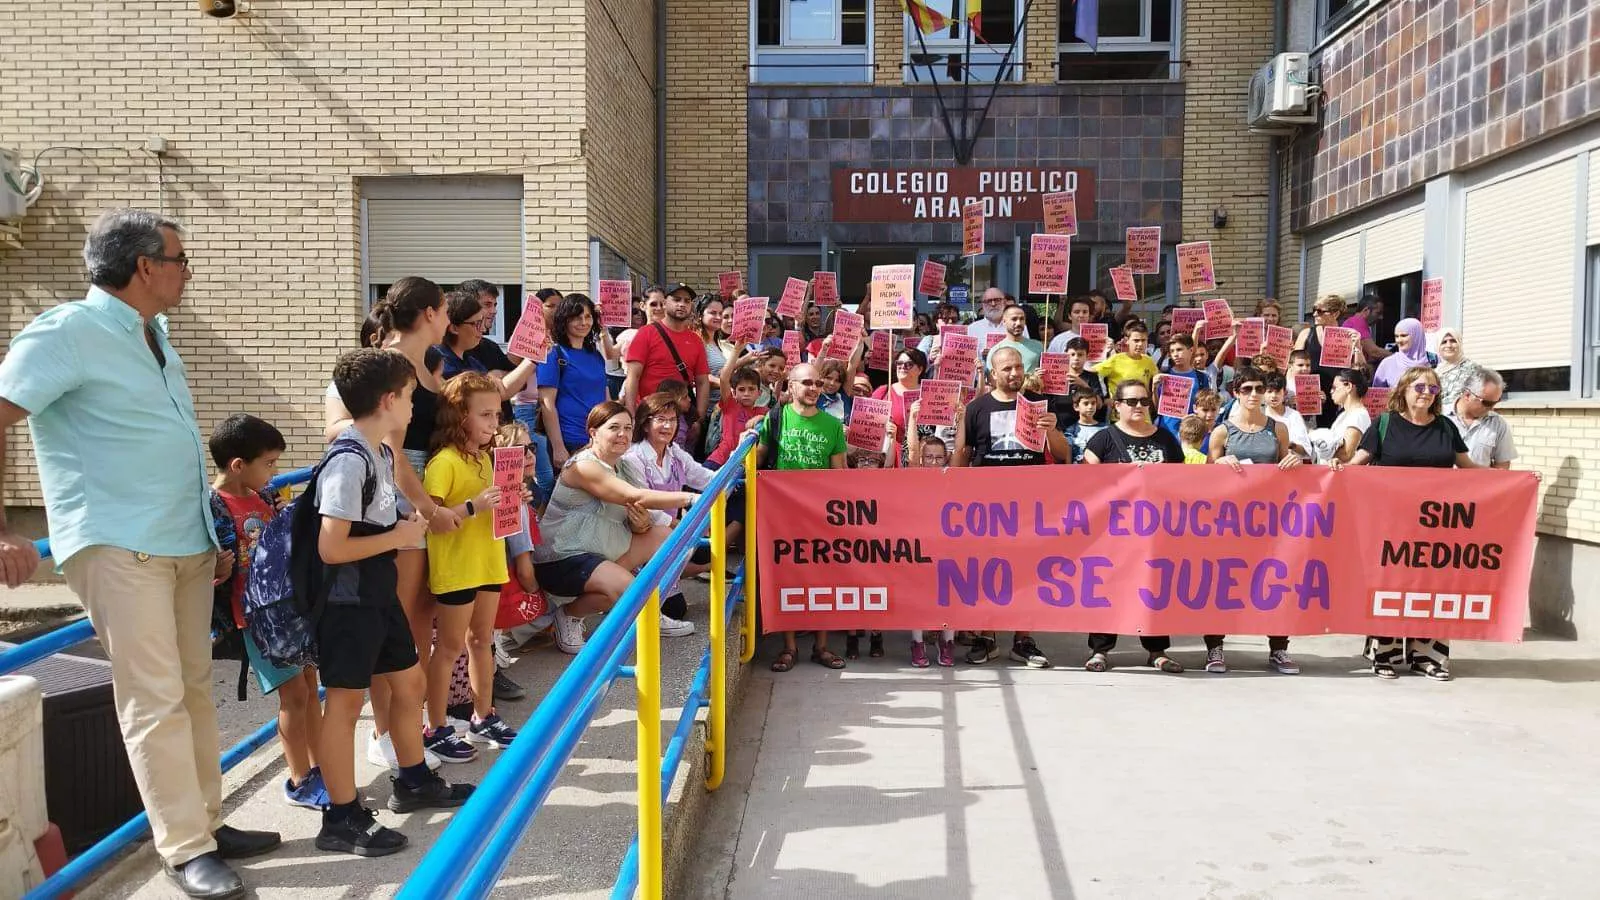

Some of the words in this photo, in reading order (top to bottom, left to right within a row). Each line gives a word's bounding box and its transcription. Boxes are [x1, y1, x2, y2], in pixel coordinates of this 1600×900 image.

[851, 172, 949, 194] COLEGIO
[979, 171, 1078, 194] PUBLICO
[854, 405, 888, 416] ESTAMOS
[826, 499, 877, 526] SIN
[940, 501, 1019, 538] CON
[1034, 500, 1091, 537] LA
[1108, 490, 1335, 539] EDUCACIÓN
[1419, 500, 1476, 529] SIN
[773, 537, 933, 565] PERSONAL
[1380, 540, 1503, 571] MEDIOS
[937, 556, 1014, 607] NO
[1036, 555, 1114, 608] SE
[1137, 557, 1331, 612] JUEGA
[780, 586, 888, 612] CCOO
[1372, 590, 1493, 621] CCOO
